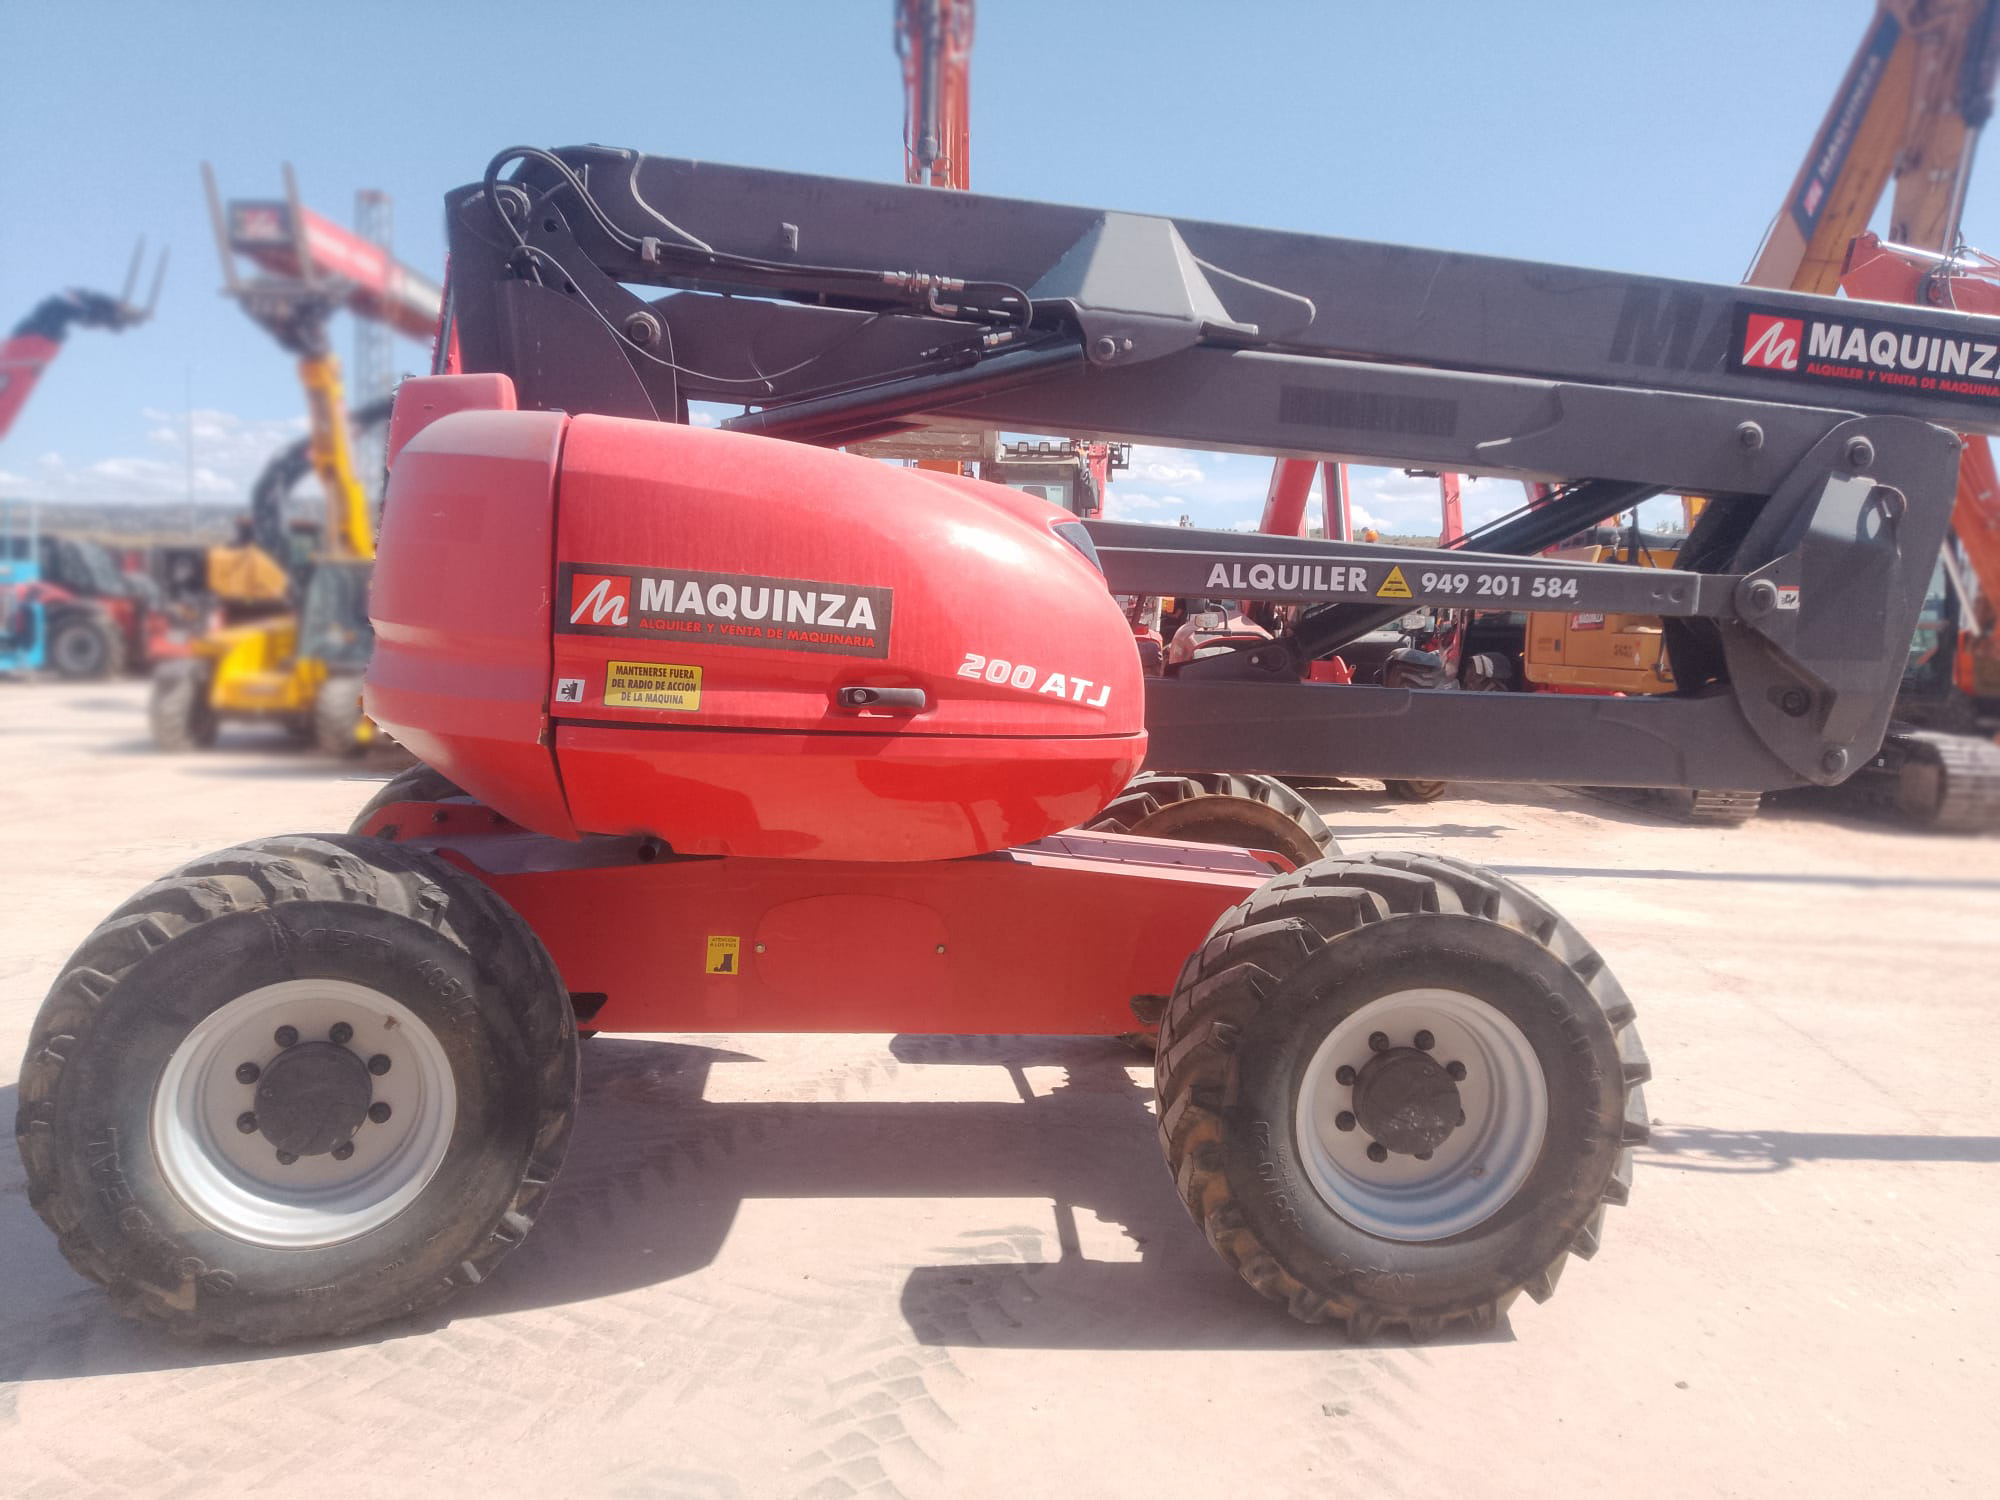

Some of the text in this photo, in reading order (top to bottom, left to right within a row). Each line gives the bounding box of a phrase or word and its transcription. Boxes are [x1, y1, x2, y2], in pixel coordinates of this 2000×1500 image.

[1808, 322, 2000, 380] MAQUINZ
[1806, 363, 1865, 381] ALQUILER
[1867, 371, 1876, 381] Y
[1879, 372, 1918, 387] VENTA
[1921, 377, 1936, 389] DE
[1206, 563, 1368, 593] ALQUILER
[1421, 572, 1470, 595] 949
[1476, 575, 1522, 597] 201
[1531, 577, 1579, 599] 584
[640, 578, 877, 631] MAQUINZA
[639, 618, 876, 648] ALQUILER Y VENTA DE MAQUINARIA
[611, 678, 625, 688] DEL
[627, 679, 653, 690] RADIO
[655, 680, 665, 690] DE
[616, 665, 695, 679] MANTENERSE FUERA
[957, 653, 1111, 707] 200 ATJ
[621, 691, 631, 701] DE
[633, 692, 643, 701] LA
